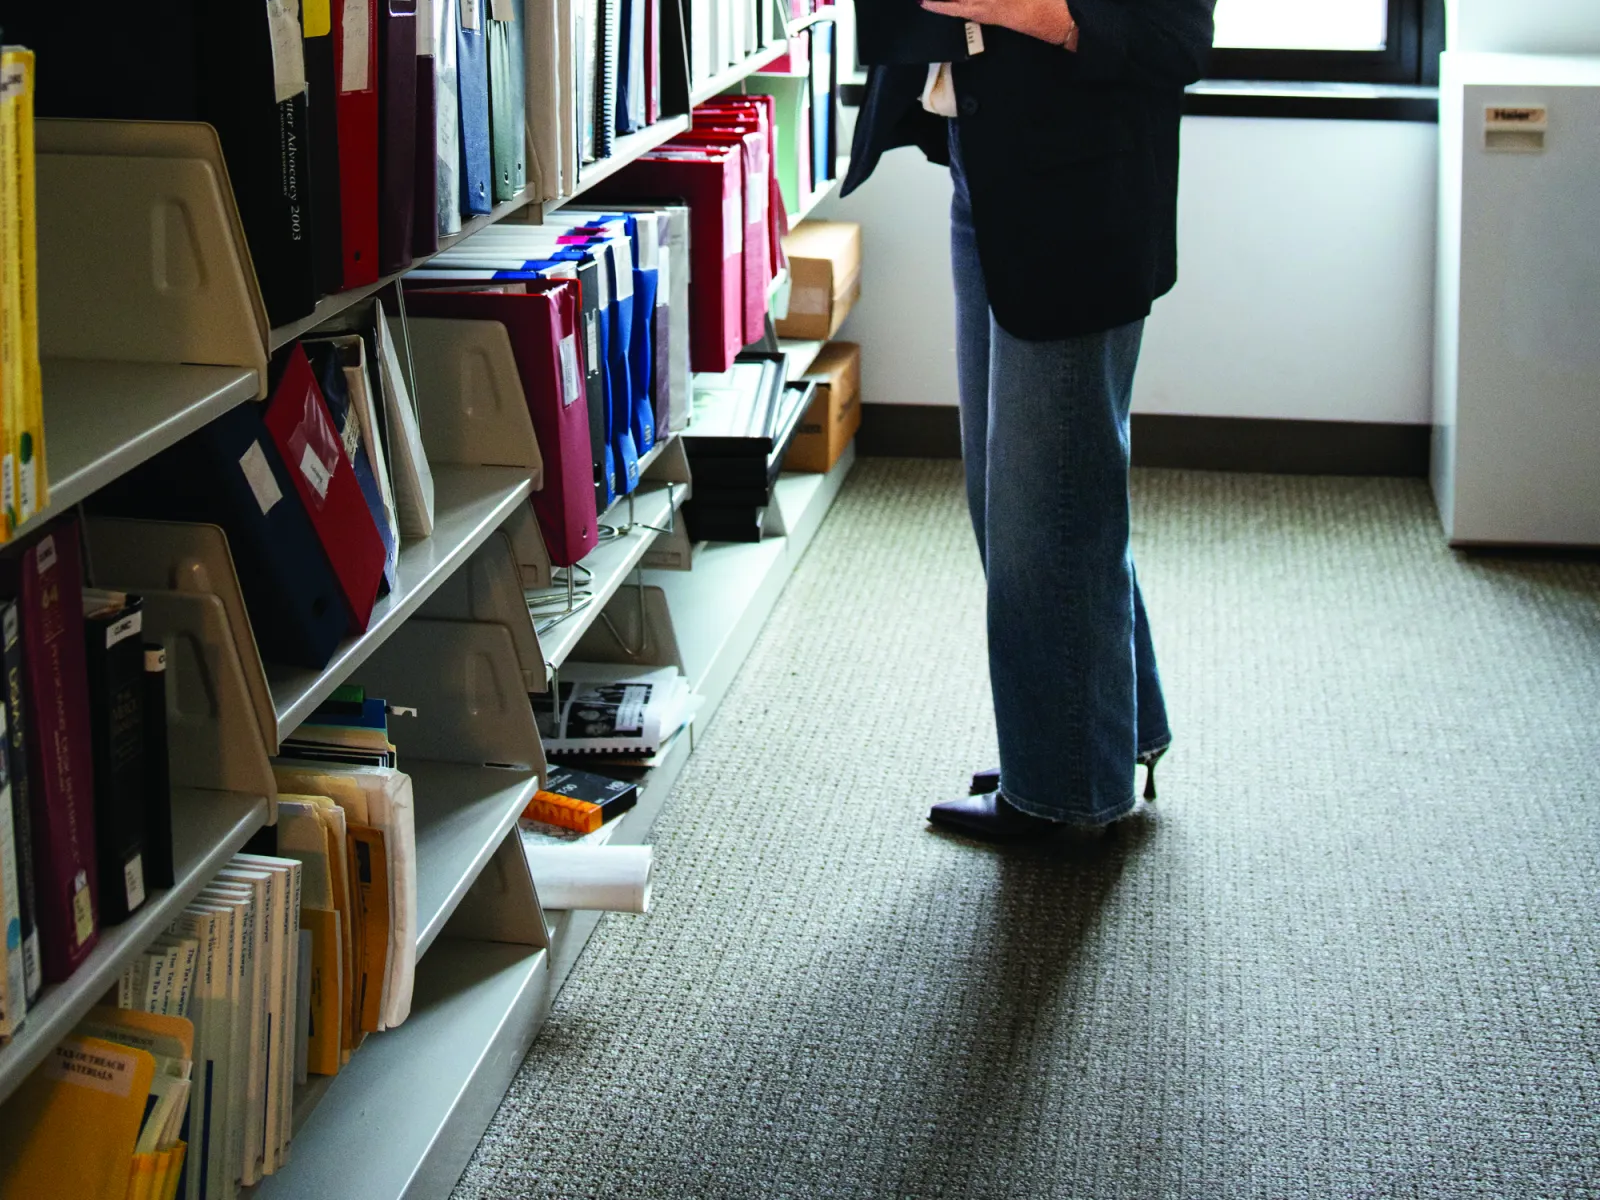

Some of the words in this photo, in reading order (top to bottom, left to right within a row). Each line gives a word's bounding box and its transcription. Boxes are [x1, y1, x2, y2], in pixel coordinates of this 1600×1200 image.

[285, 97, 295, 128] tter
[286, 132, 298, 201] Advocacy
[290, 205, 302, 241] 2003
[155, 961, 164, 977] The
[152, 980, 161, 995] Tax
[56, 1046, 74, 1059] TAX
[75, 1050, 126, 1072] OUTREACH
[62, 1061, 113, 1081] MATERIALS
